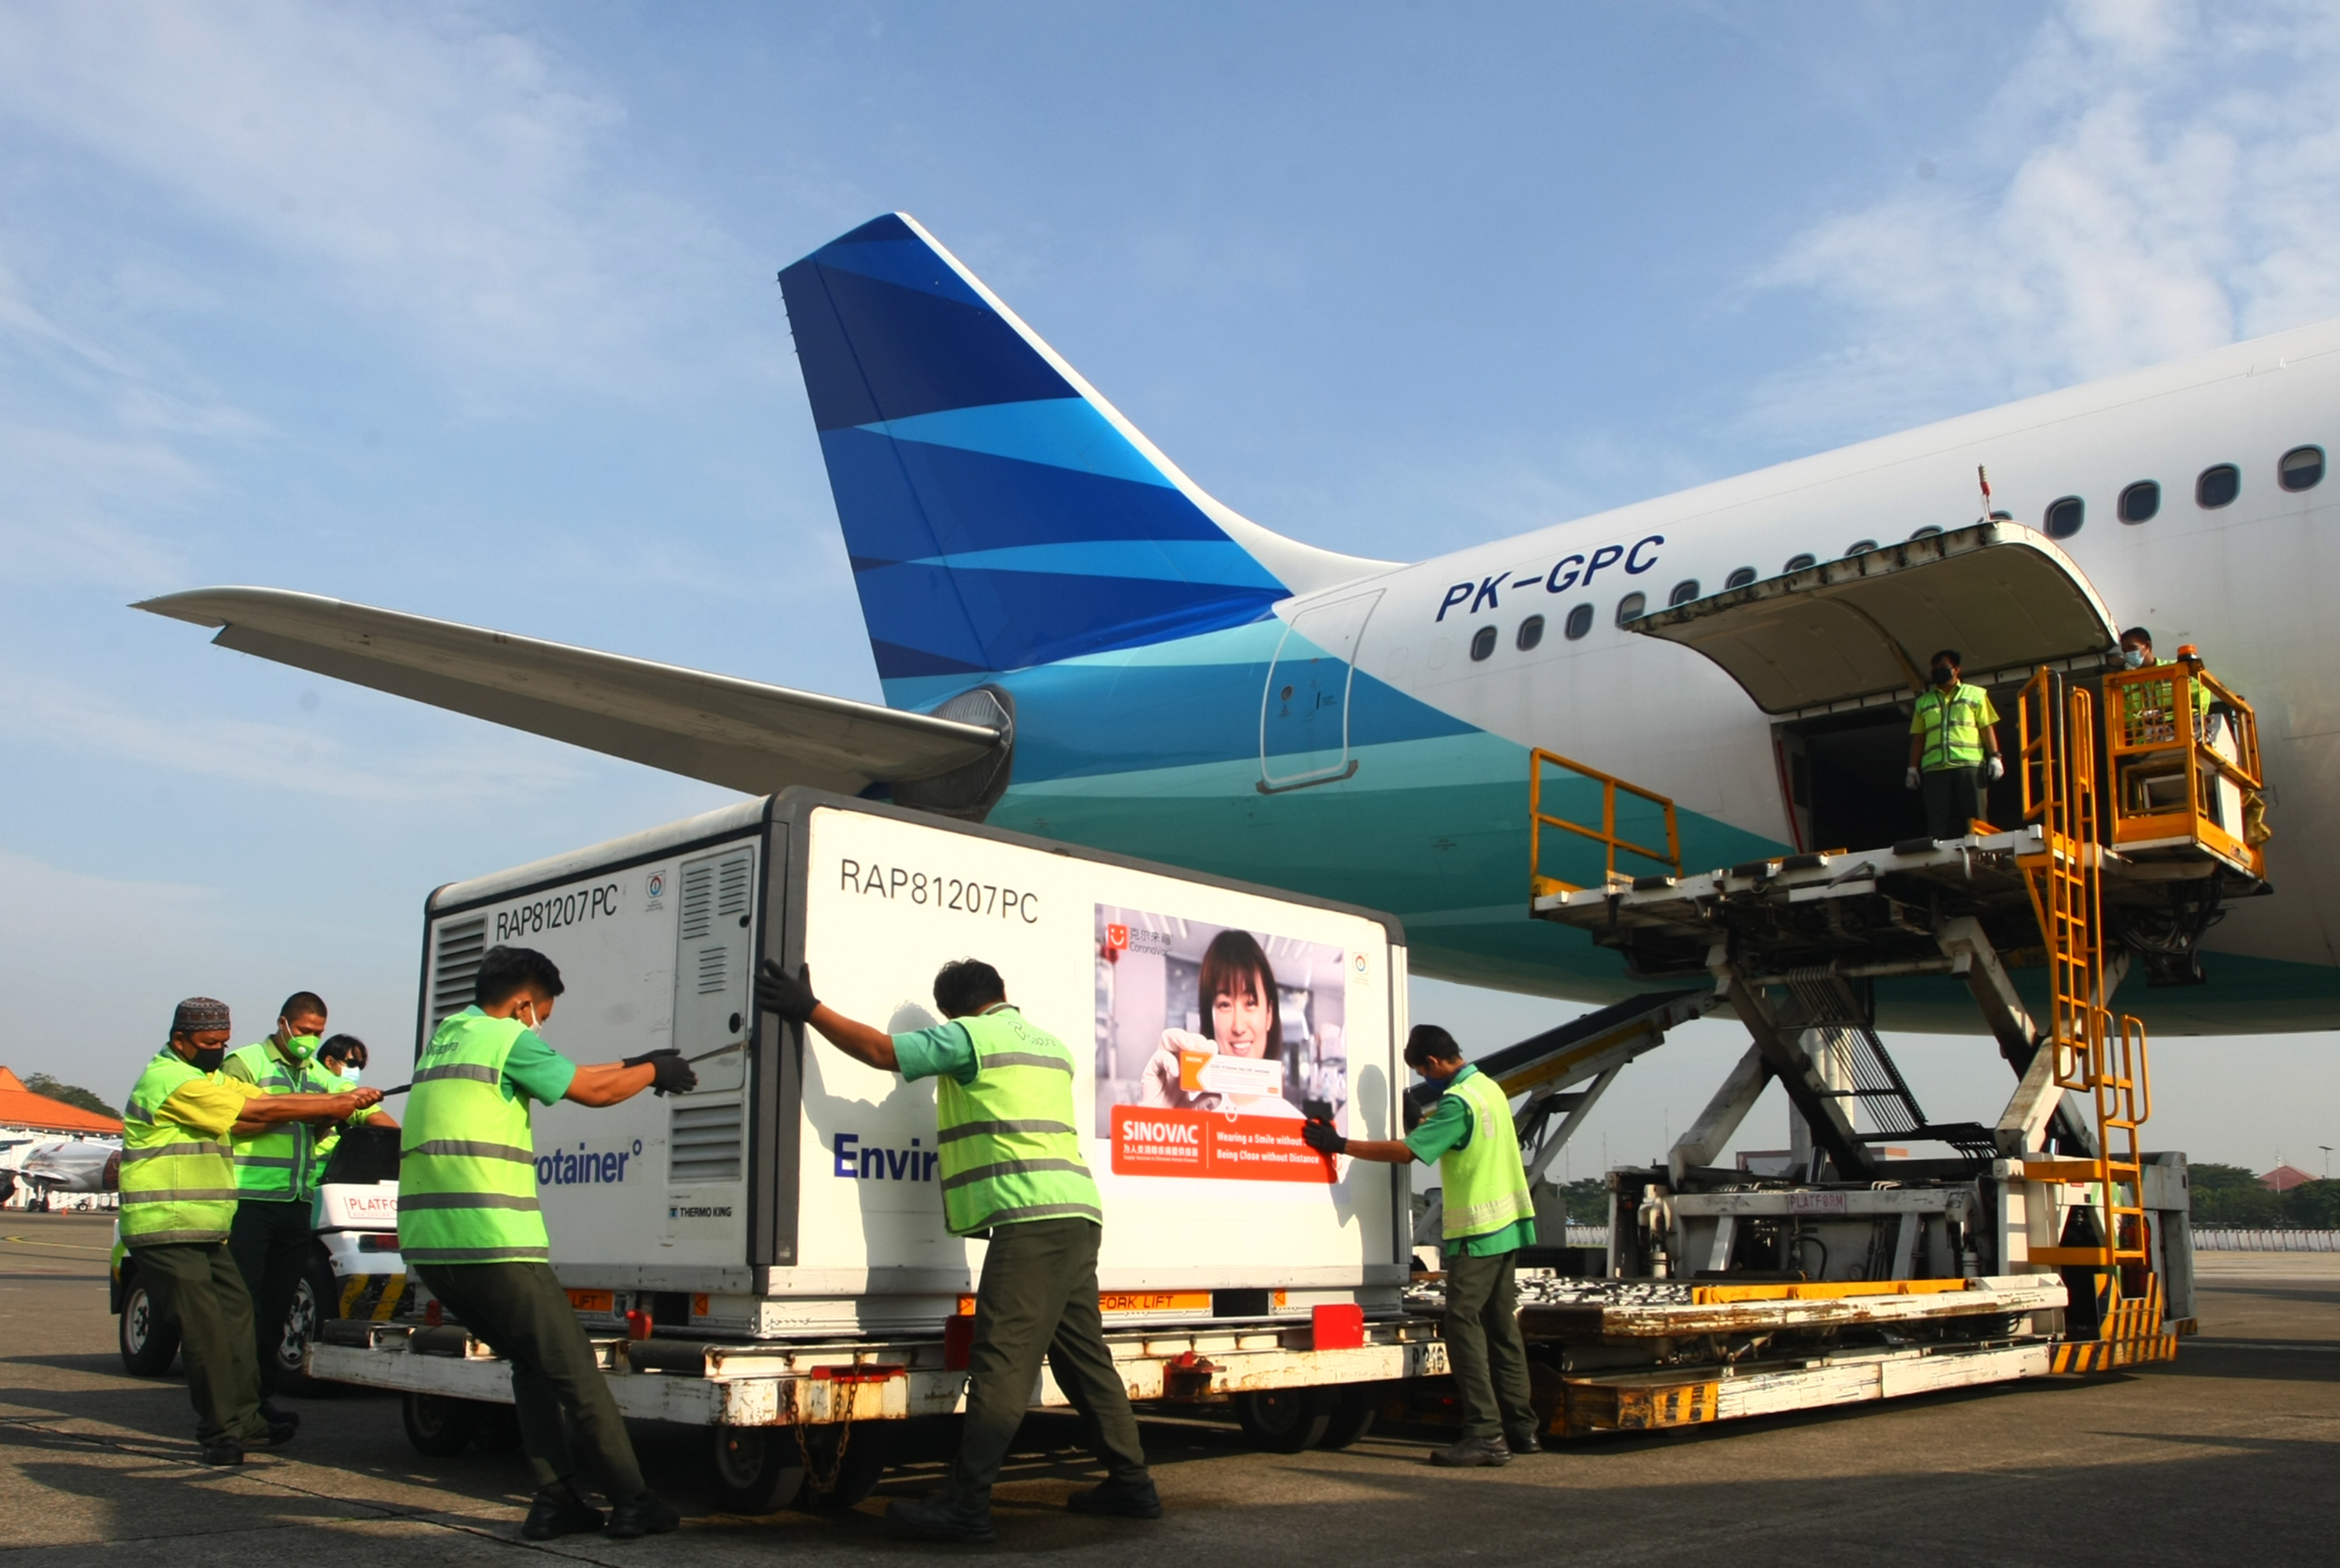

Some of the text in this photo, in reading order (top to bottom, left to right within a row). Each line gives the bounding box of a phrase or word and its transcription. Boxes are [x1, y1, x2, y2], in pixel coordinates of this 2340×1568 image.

[1435, 535, 1665, 623] PK-GPC
[841, 858, 1038, 924] RAP81207PC
[496, 883, 618, 942] RAP81207PC
[1123, 1120, 1198, 1144] SINOVAC
[1216, 1131, 1247, 1145] Wearing
[1254, 1134, 1275, 1144] Smile
[1276, 1136, 1303, 1146] without
[834, 1132, 938, 1182] Envir
[1216, 1149, 1320, 1164] Being Close without Distance
[349, 1198, 398, 1211] PLATFO
[1790, 1195, 1843, 1208] PLATFORM
[680, 1207, 712, 1217] THERMO
[713, 1207, 732, 1217] KING
[1143, 1295, 1174, 1308] LIFT
